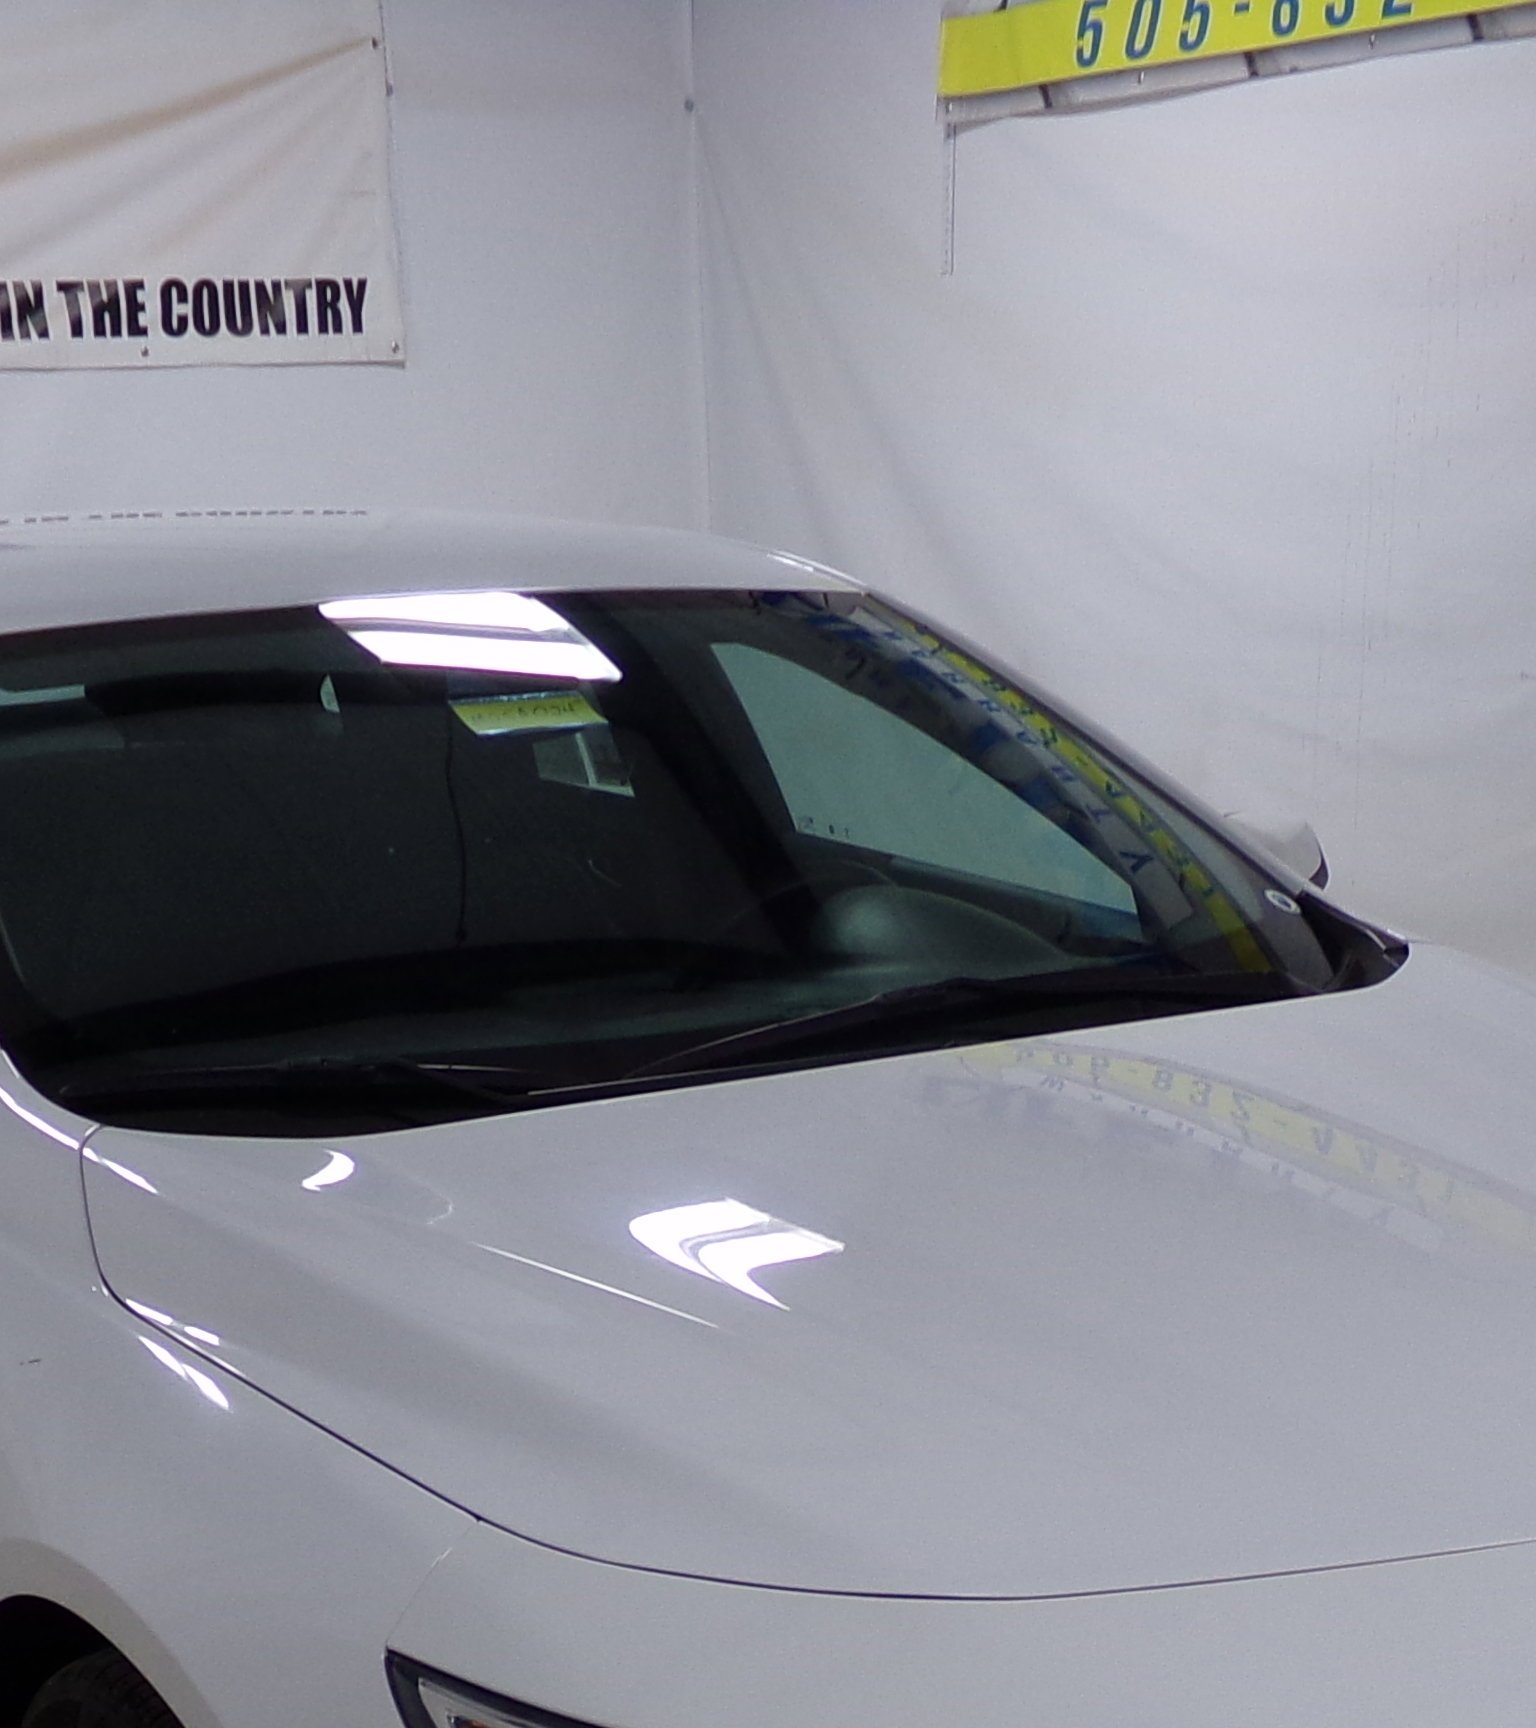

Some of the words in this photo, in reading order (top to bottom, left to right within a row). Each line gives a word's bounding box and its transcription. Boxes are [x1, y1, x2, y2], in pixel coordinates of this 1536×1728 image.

[1076, 0, 1413, 68] 505-
[58, 279, 150, 341] THE
[160, 277, 369, 340] COUNTRY
